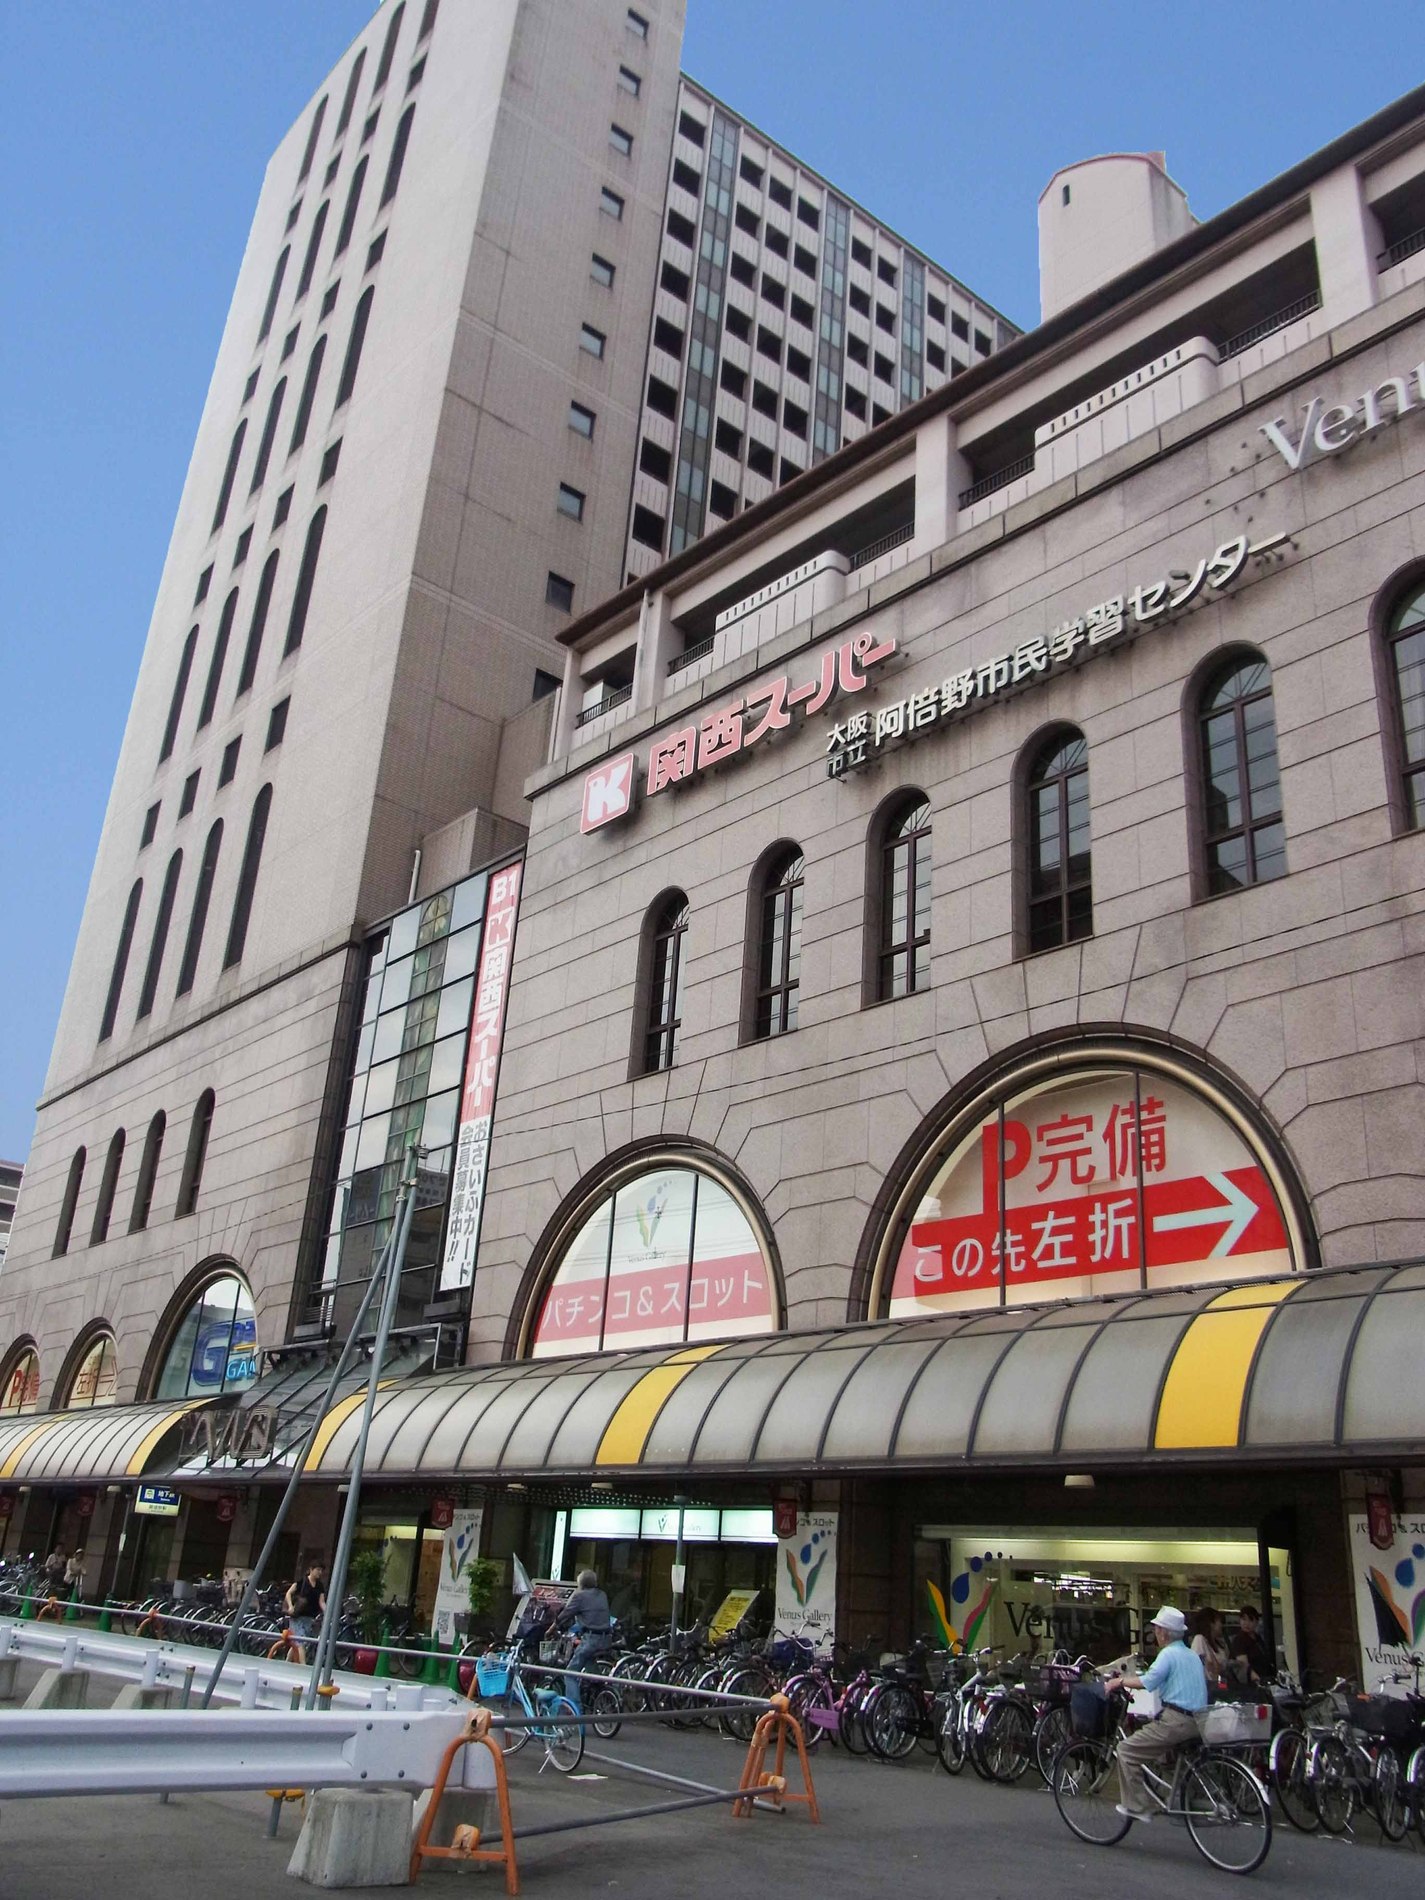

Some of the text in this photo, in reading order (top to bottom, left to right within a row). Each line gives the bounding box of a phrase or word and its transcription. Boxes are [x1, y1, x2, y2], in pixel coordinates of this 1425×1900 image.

[875, 532, 1291, 747] 阿倍野市民学習センター
[647, 632, 896, 796] 関西スーパー
[827, 710, 868, 752] 大阪
[827, 740, 868, 776] 市立
[491, 869, 518, 905] B1
[466, 946, 509, 1107] 関西スーパー
[982, 1096, 1167, 1212] P完備
[459, 1120, 488, 1285] おさいふカード
[914, 1198, 1137, 1282] この先左折
[542, 1269, 764, 1330] パチンコ&スロット
[777, 1607, 833, 1623] Venus Gallery
[1364, 1647, 1408, 1665] Venus
